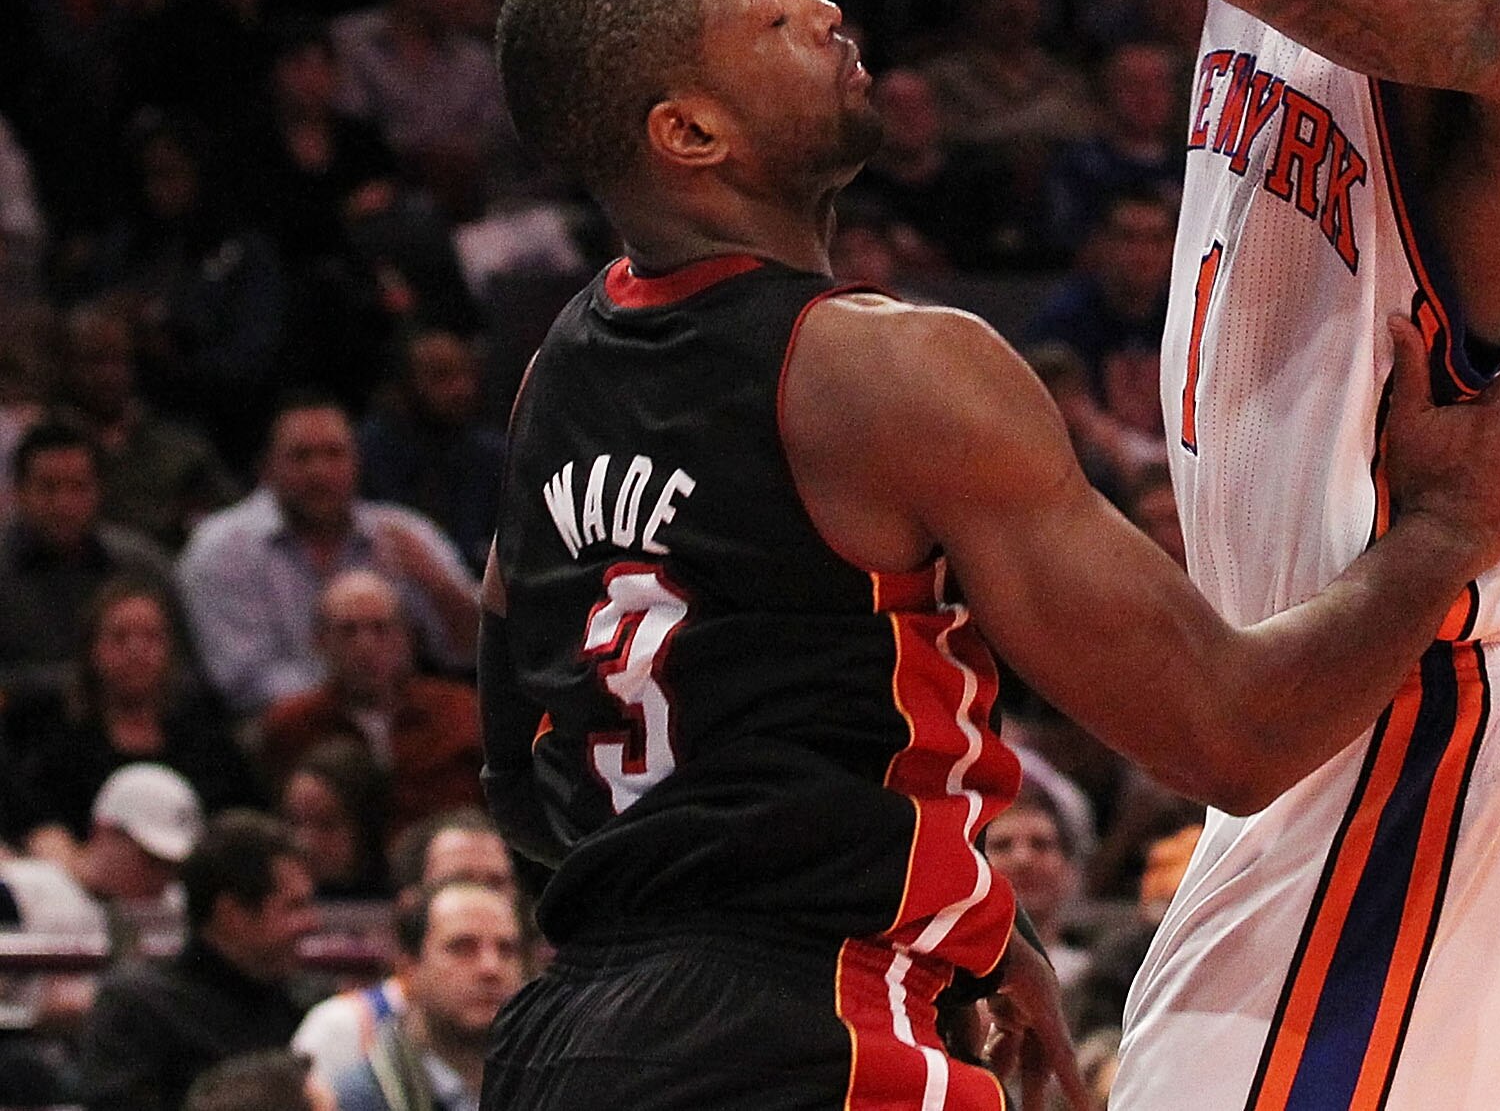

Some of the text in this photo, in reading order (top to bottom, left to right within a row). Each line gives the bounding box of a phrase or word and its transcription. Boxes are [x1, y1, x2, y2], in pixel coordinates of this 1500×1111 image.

[1187, 49, 1368, 276] EW YRK
[1181, 238, 1224, 457] 1
[543, 453, 696, 560] WADE
[582, 561, 690, 815] 3
